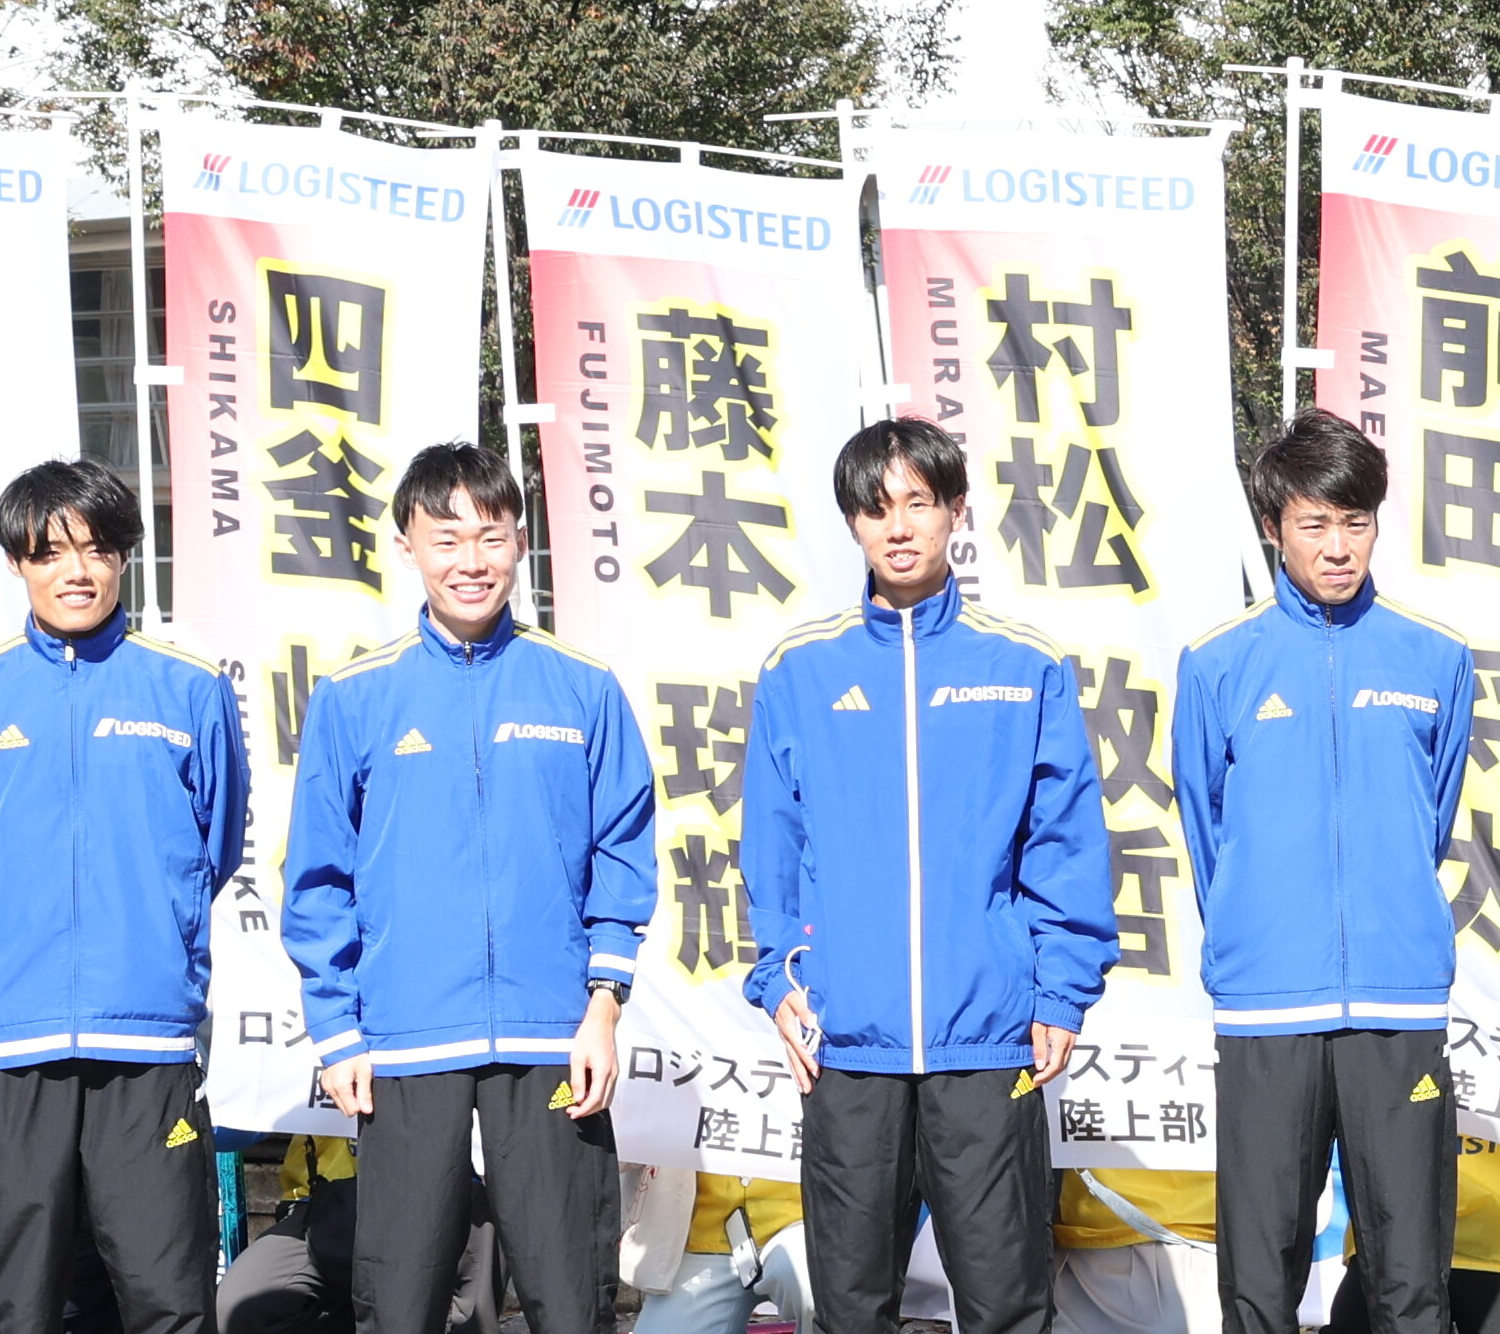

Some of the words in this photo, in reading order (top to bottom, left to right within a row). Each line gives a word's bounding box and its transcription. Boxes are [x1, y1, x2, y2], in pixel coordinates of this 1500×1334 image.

[238, 160, 465, 223] LOGISTEED
[961, 168, 1196, 211] LOGISTEED
[610, 194, 831, 252] LOGISTEED
[206, 298, 241, 539] SHIKAMA
[265, 269, 387, 592] 四釜
[986, 272, 1151, 595] 村松
[577, 319, 622, 584] FUJIMOTO
[636, 308, 797, 620] 藤本
[950, 685, 1033, 703] LOGISTEED
[115, 720, 192, 747] LOGISTEED
[1059, 1098, 1207, 1144] 陸上部
